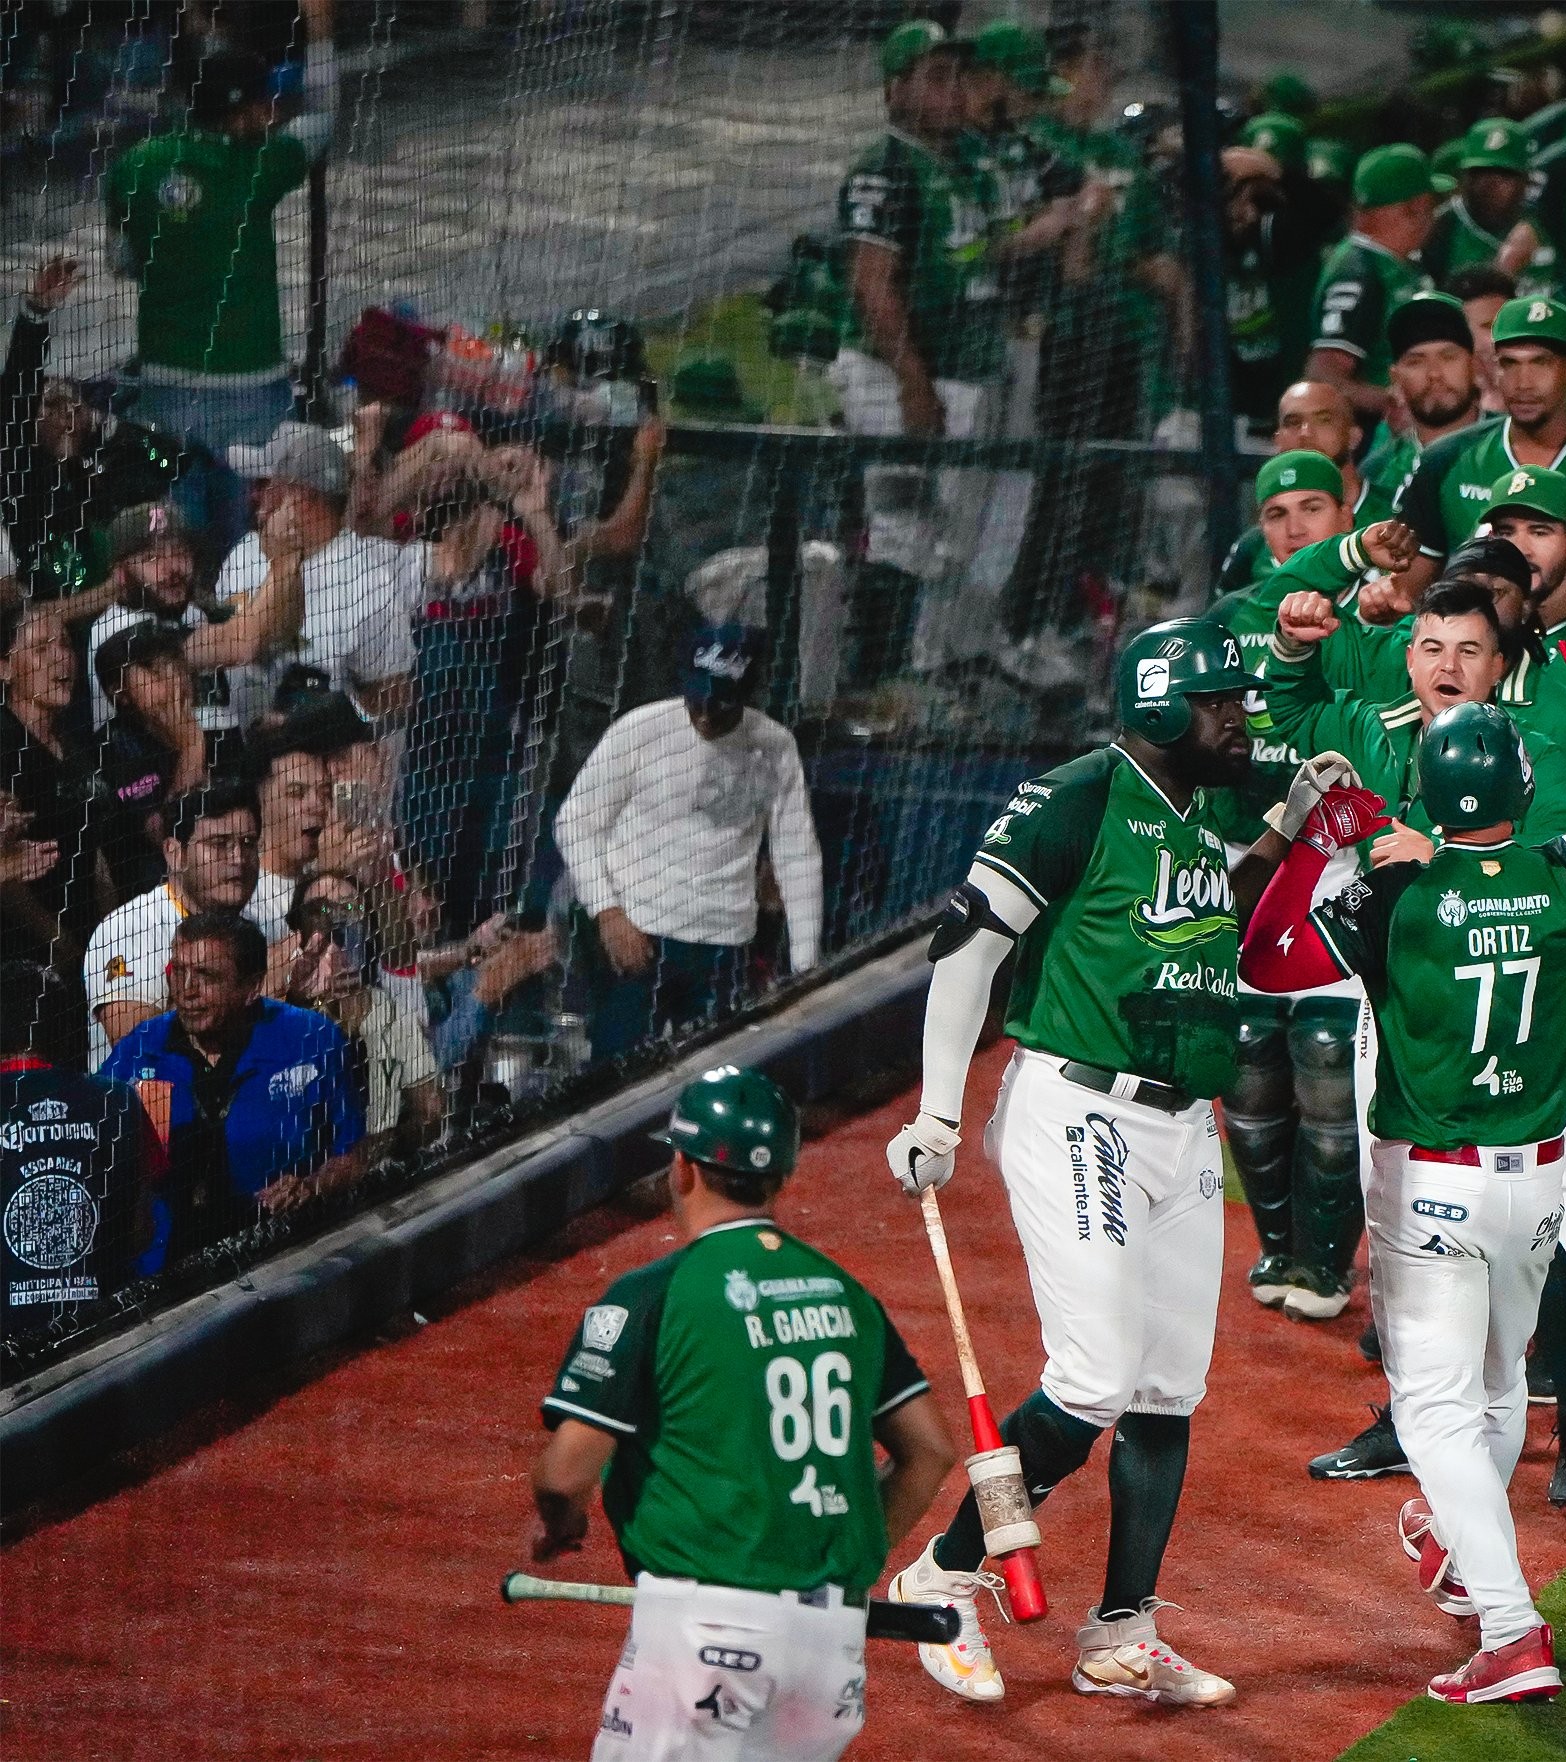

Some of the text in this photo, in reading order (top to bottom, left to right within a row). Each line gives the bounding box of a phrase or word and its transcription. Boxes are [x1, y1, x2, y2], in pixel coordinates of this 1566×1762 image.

[1463, 800, 1475, 810] 77
[1142, 849, 1235, 925] León
[1467, 894, 1550, 914] GUANAJUATO
[1468, 924, 1533, 957] ORTIZ
[1454, 956, 1541, 1054] 77
[1502, 1069, 1516, 1078] TV
[1502, 1077, 1522, 1086] CUA
[1502, 1084, 1523, 1094] TRO
[1068, 1145, 1091, 1242] caliente.mx
[1085, 1112, 1131, 1247] Caliente
[744, 1304, 858, 1349] R. GARCIA
[766, 1351, 852, 1461] 86
